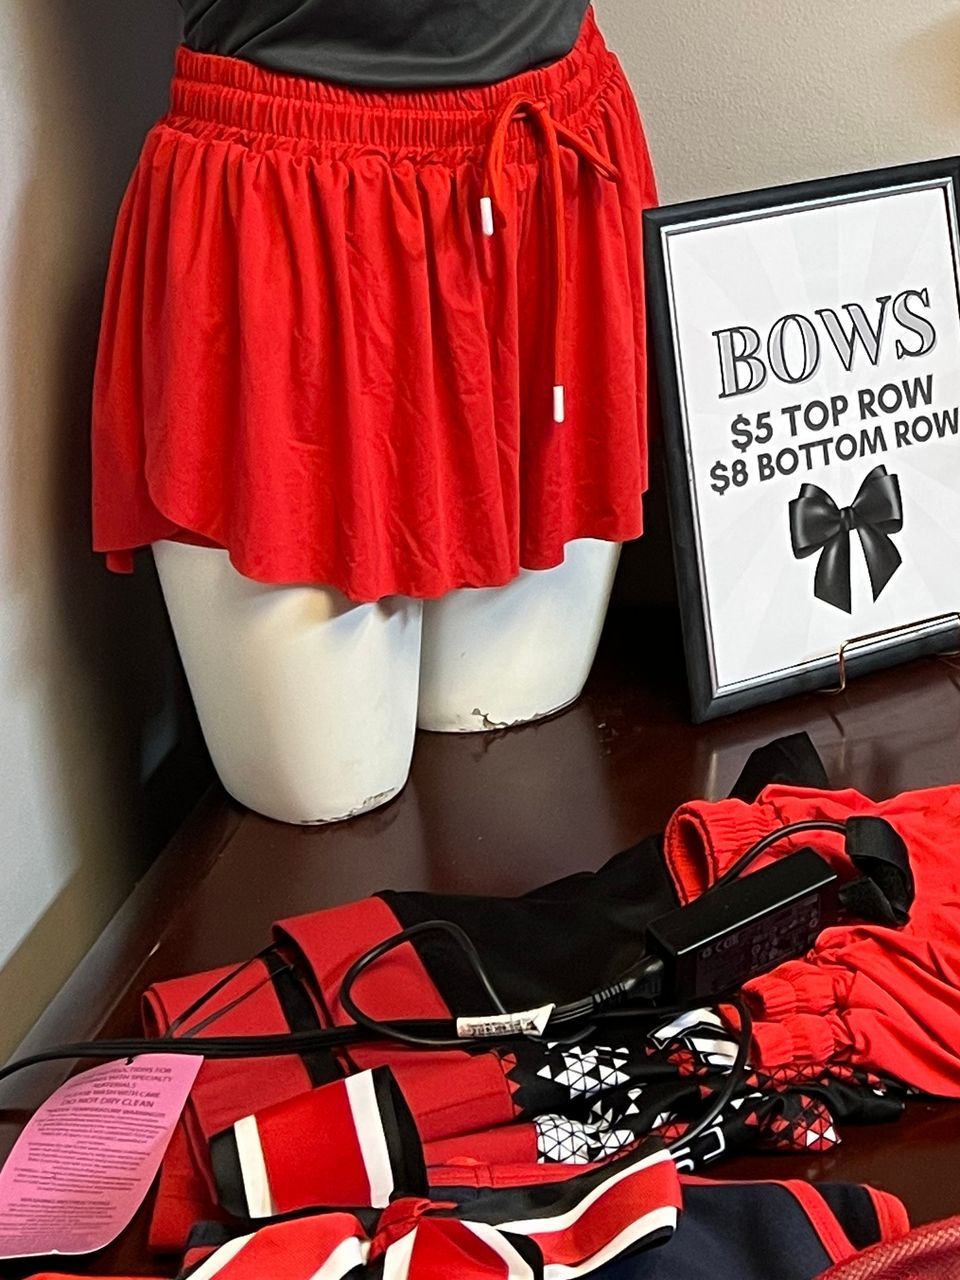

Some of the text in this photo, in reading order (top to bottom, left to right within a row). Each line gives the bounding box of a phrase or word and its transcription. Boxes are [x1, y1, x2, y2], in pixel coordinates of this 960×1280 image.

[712, 288, 937, 399] BOWS
[710, 407, 959, 496] $8 BOTTOM ROW
[730, 374, 933, 453] $5 TOP ROW
